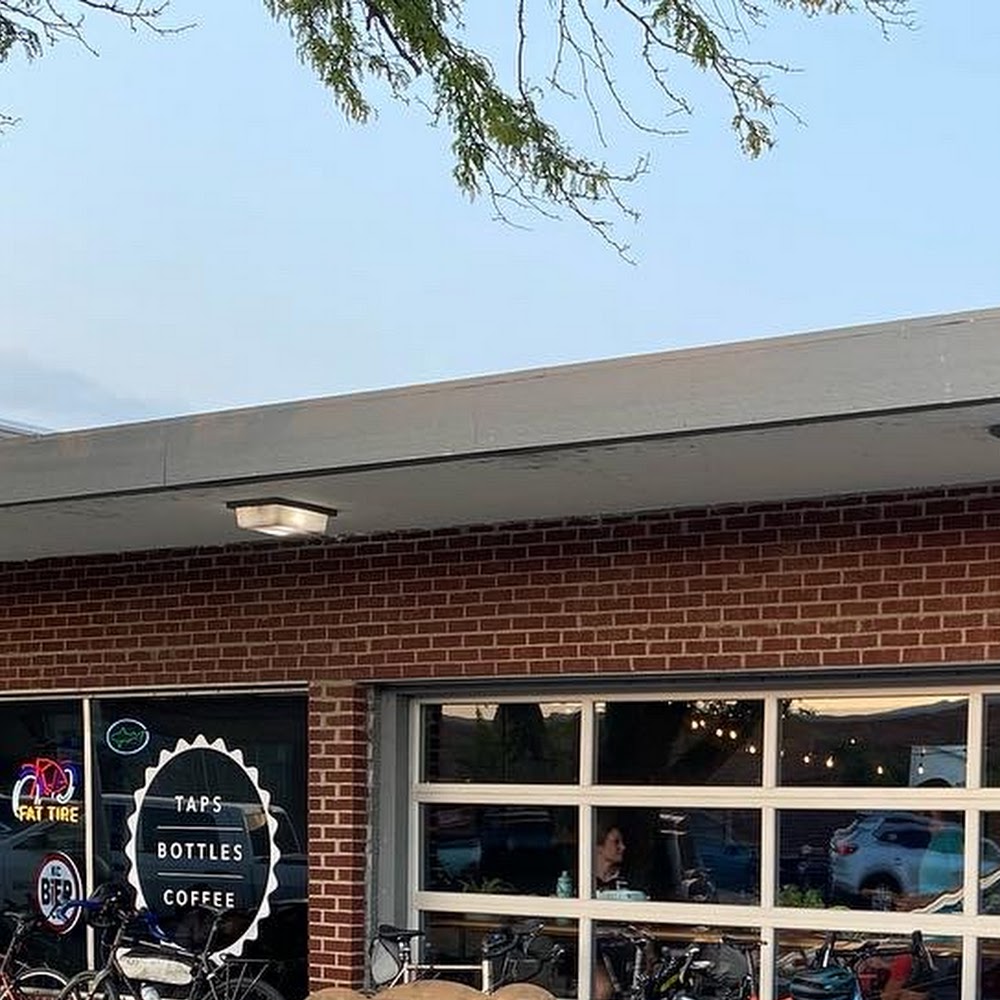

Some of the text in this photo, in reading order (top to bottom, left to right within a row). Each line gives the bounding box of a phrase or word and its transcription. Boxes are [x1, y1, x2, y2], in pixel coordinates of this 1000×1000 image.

[174, 795, 222, 813] TAPS
[19, 804, 79, 824] FAT TIRE
[157, 842, 243, 861] BOTTLES
[163, 889, 235, 909] COFFEE
